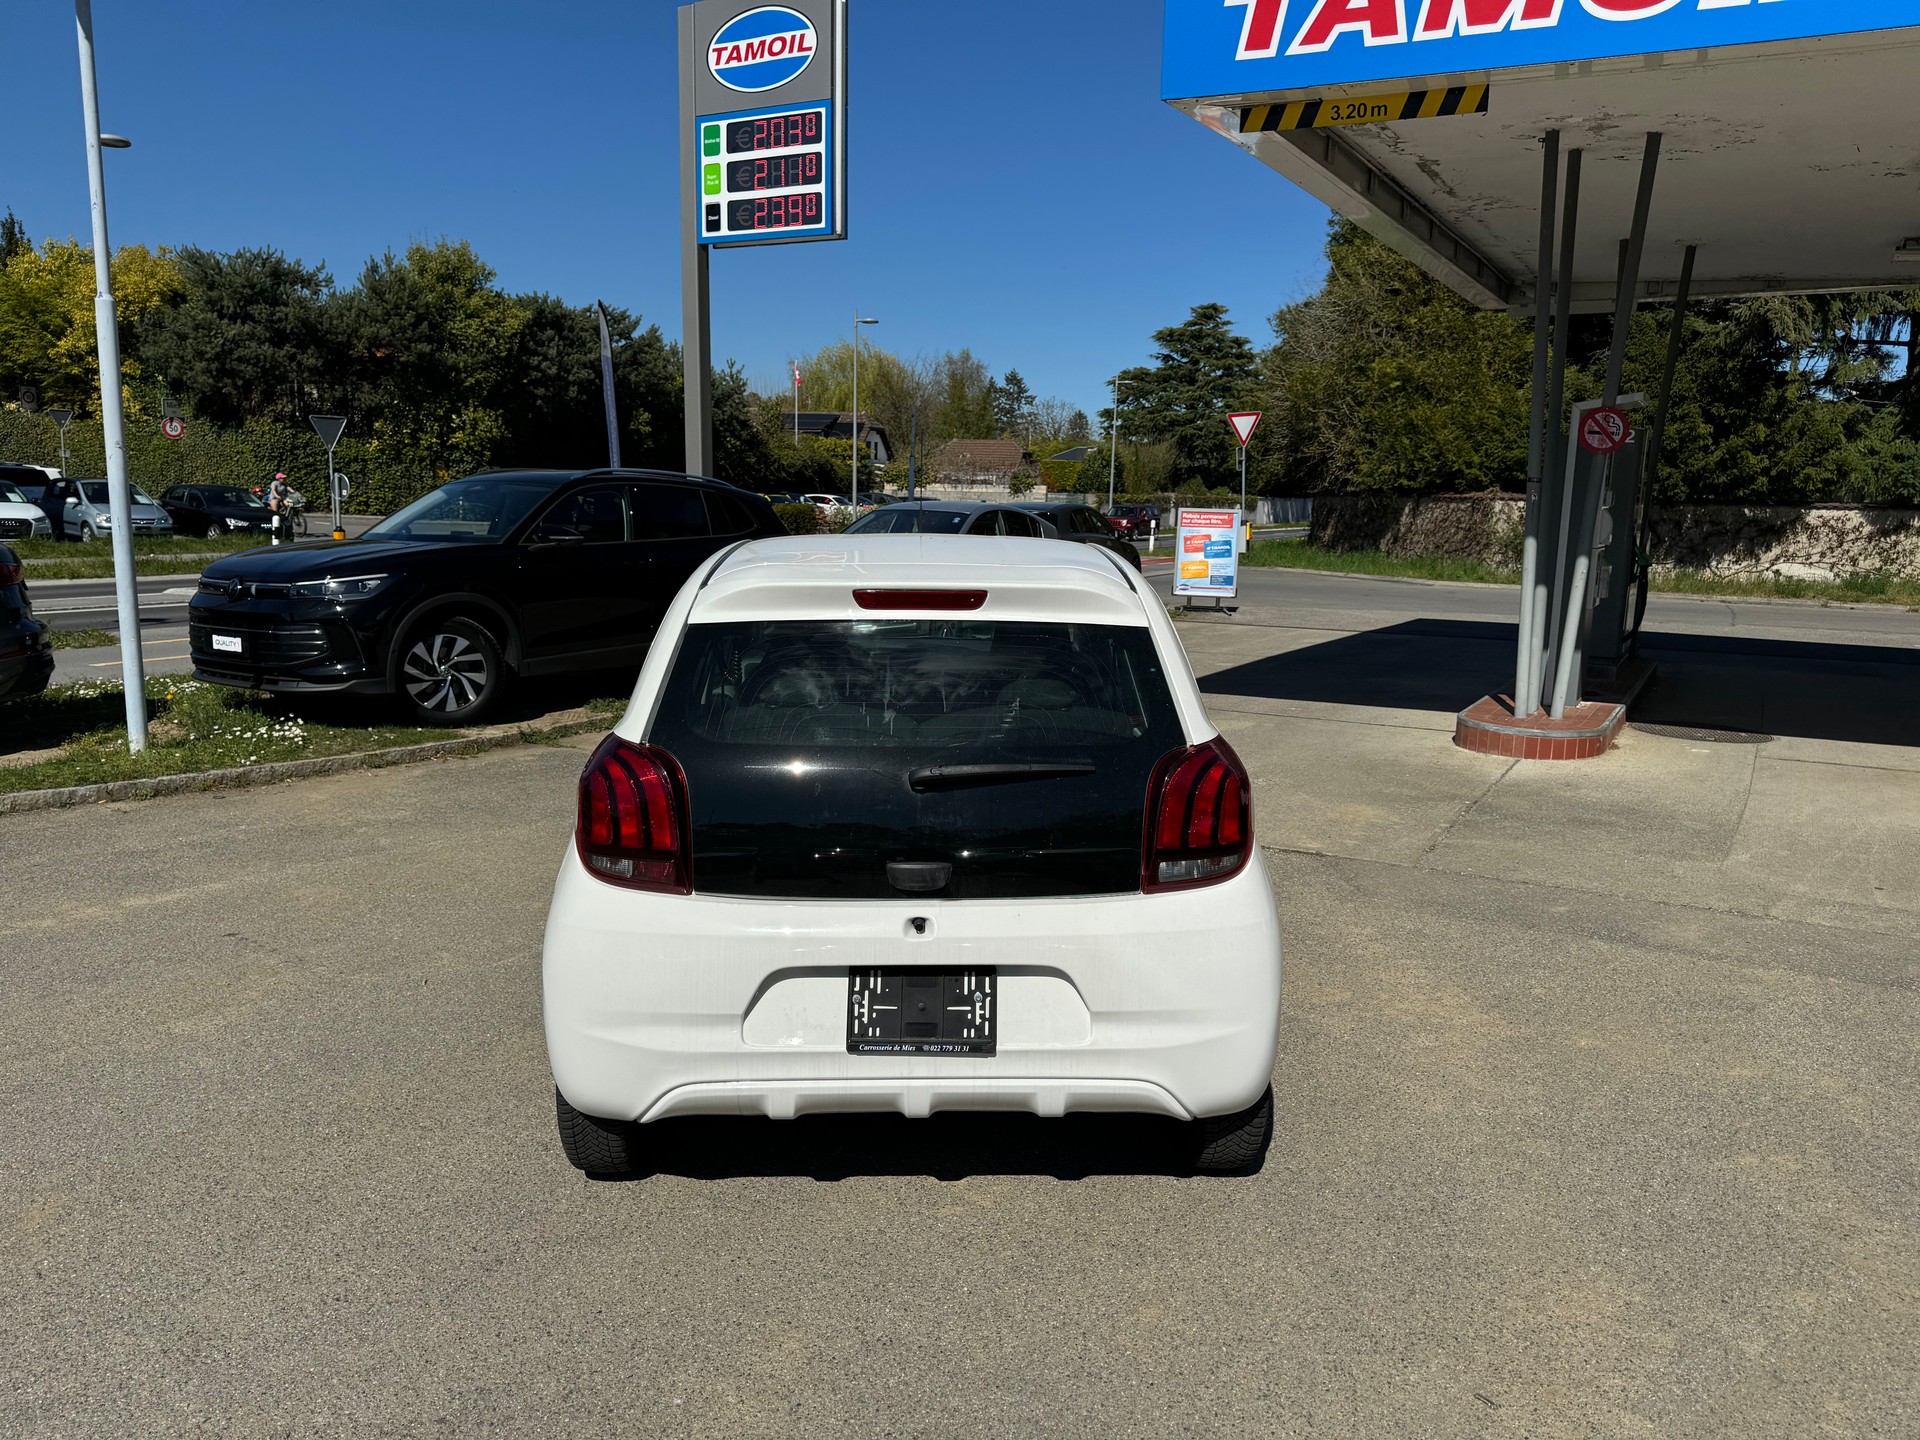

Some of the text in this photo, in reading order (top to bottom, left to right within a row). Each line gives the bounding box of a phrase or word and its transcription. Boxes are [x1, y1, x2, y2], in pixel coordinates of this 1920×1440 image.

[712, 33, 812, 66] TAMOIL
[1330, 103, 1388, 121] 3.20 m
[169, 424, 179, 433] 50
